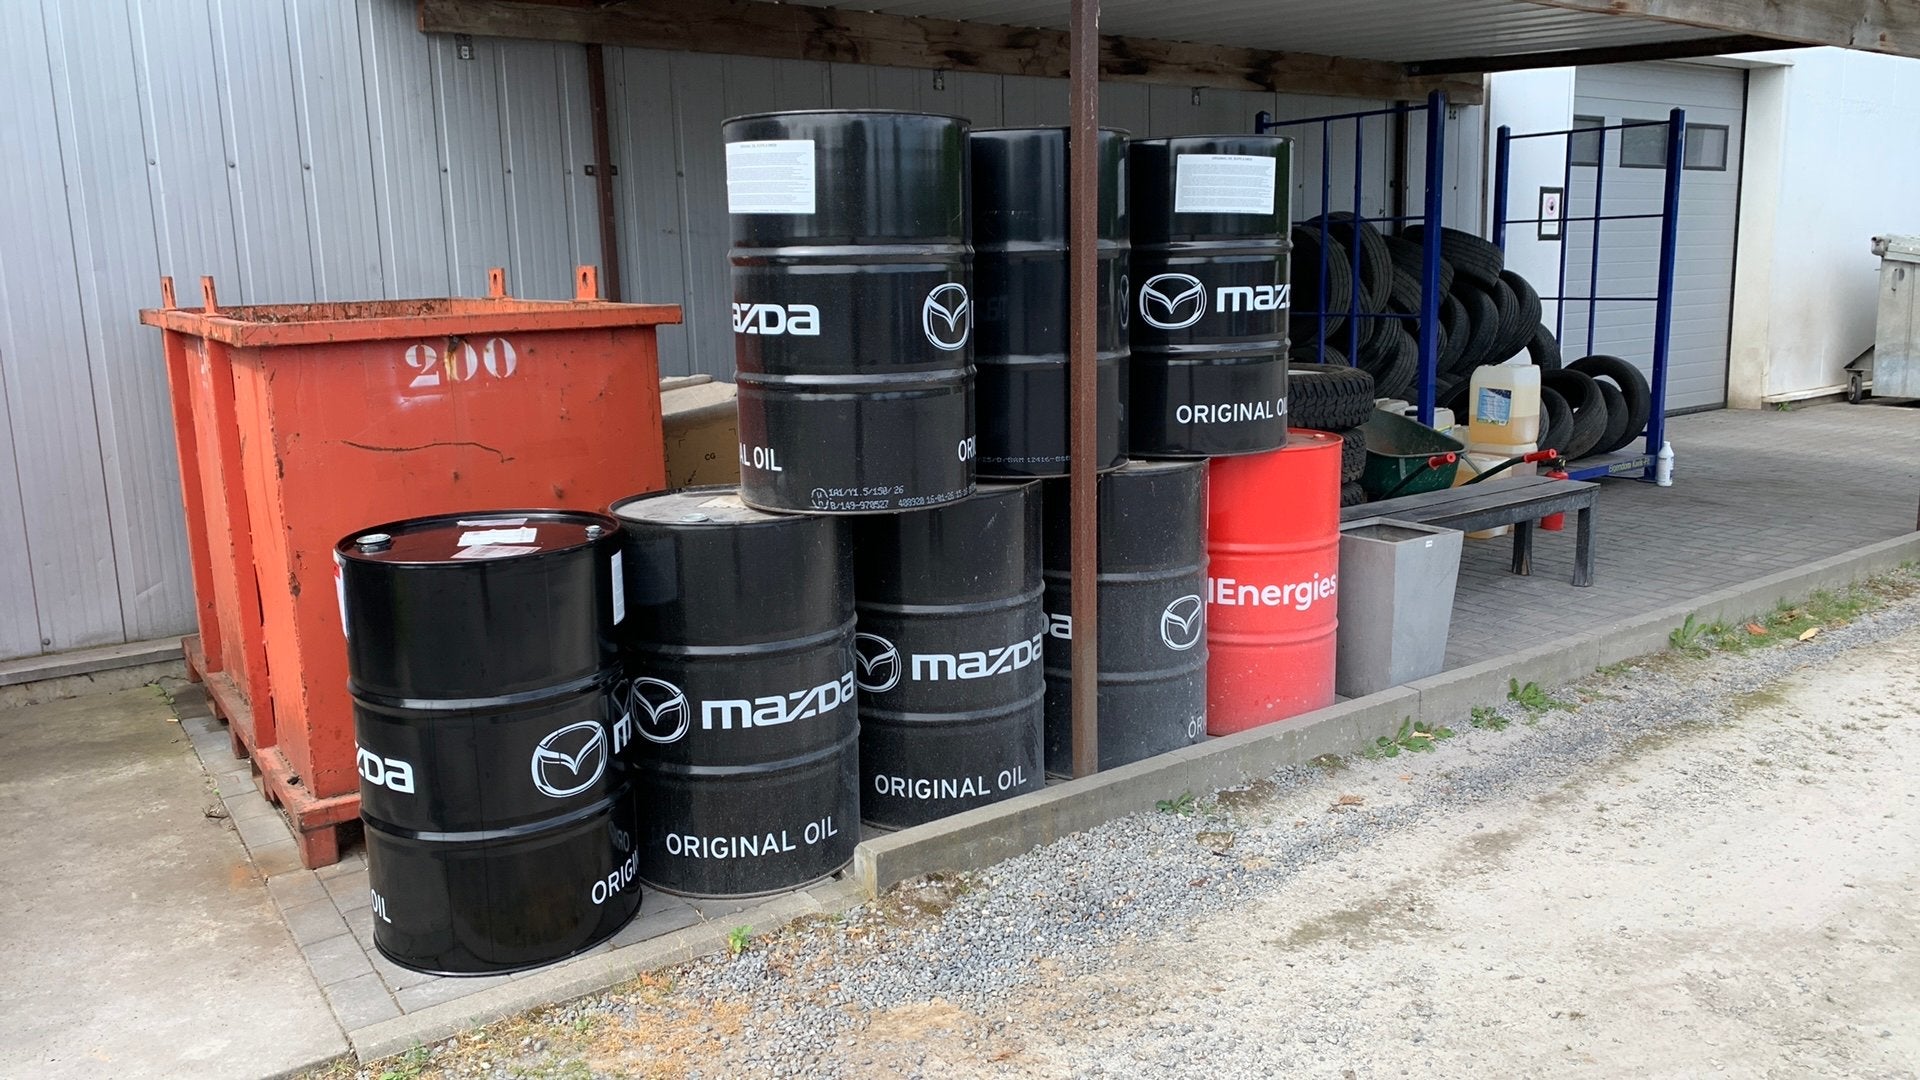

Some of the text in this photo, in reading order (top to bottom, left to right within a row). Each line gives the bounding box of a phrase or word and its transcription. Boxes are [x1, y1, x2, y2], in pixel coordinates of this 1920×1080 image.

[405, 337, 518, 388] 200
[1176, 400, 1274, 424] ORIGINAL
[753, 446, 783, 471] OIL
[912, 632, 1042, 681] mazda
[701, 670, 854, 730] mazda
[875, 764, 1027, 800] ORIGINAL OIL
[666, 816, 838, 859] ORIGINAL OIL
[371, 888, 392, 923] OIL
